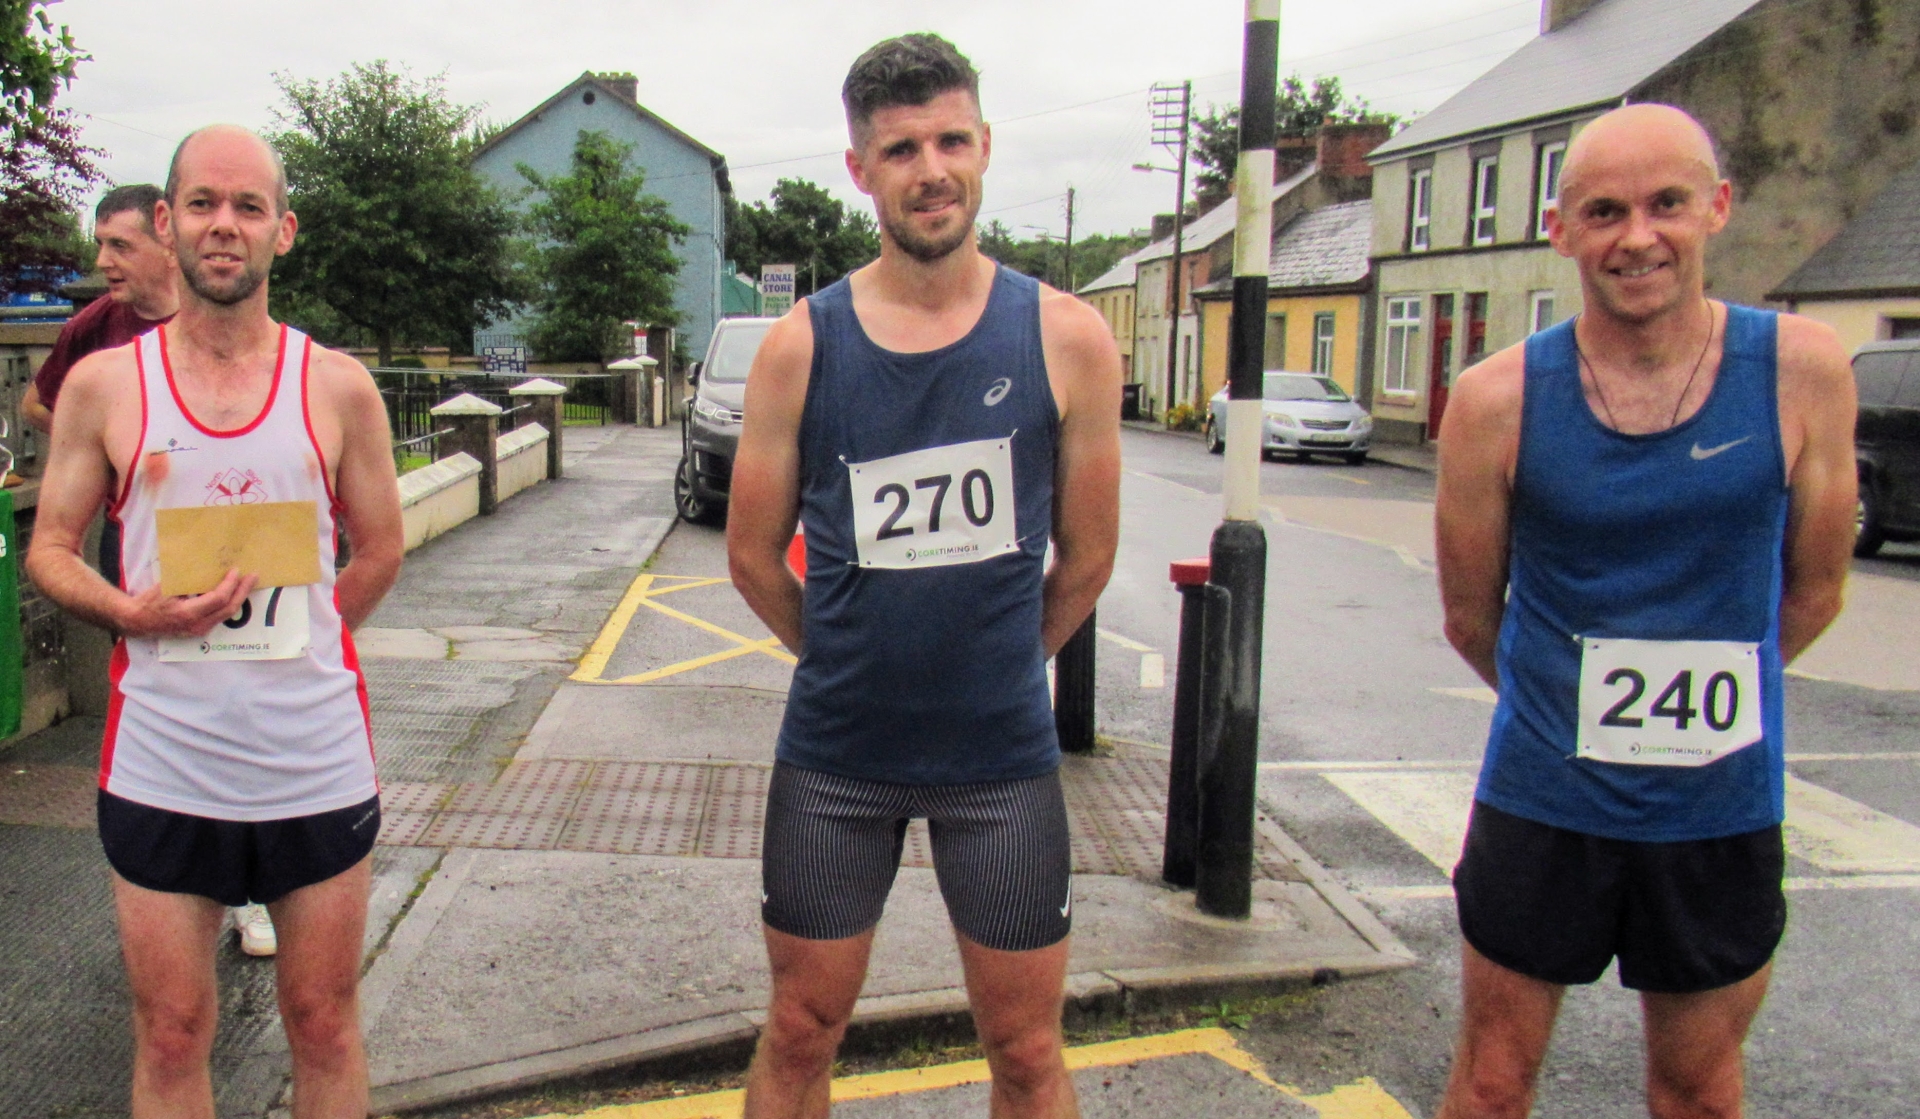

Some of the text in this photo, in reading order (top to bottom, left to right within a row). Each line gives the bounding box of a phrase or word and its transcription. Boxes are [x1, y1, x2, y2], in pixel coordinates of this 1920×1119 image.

[763, 273, 793, 282] CANAL
[763, 284, 792, 292] STORE
[205, 468, 263, 489] North Sligo
[873, 468, 995, 542] 270
[1599, 667, 1739, 732] 240
